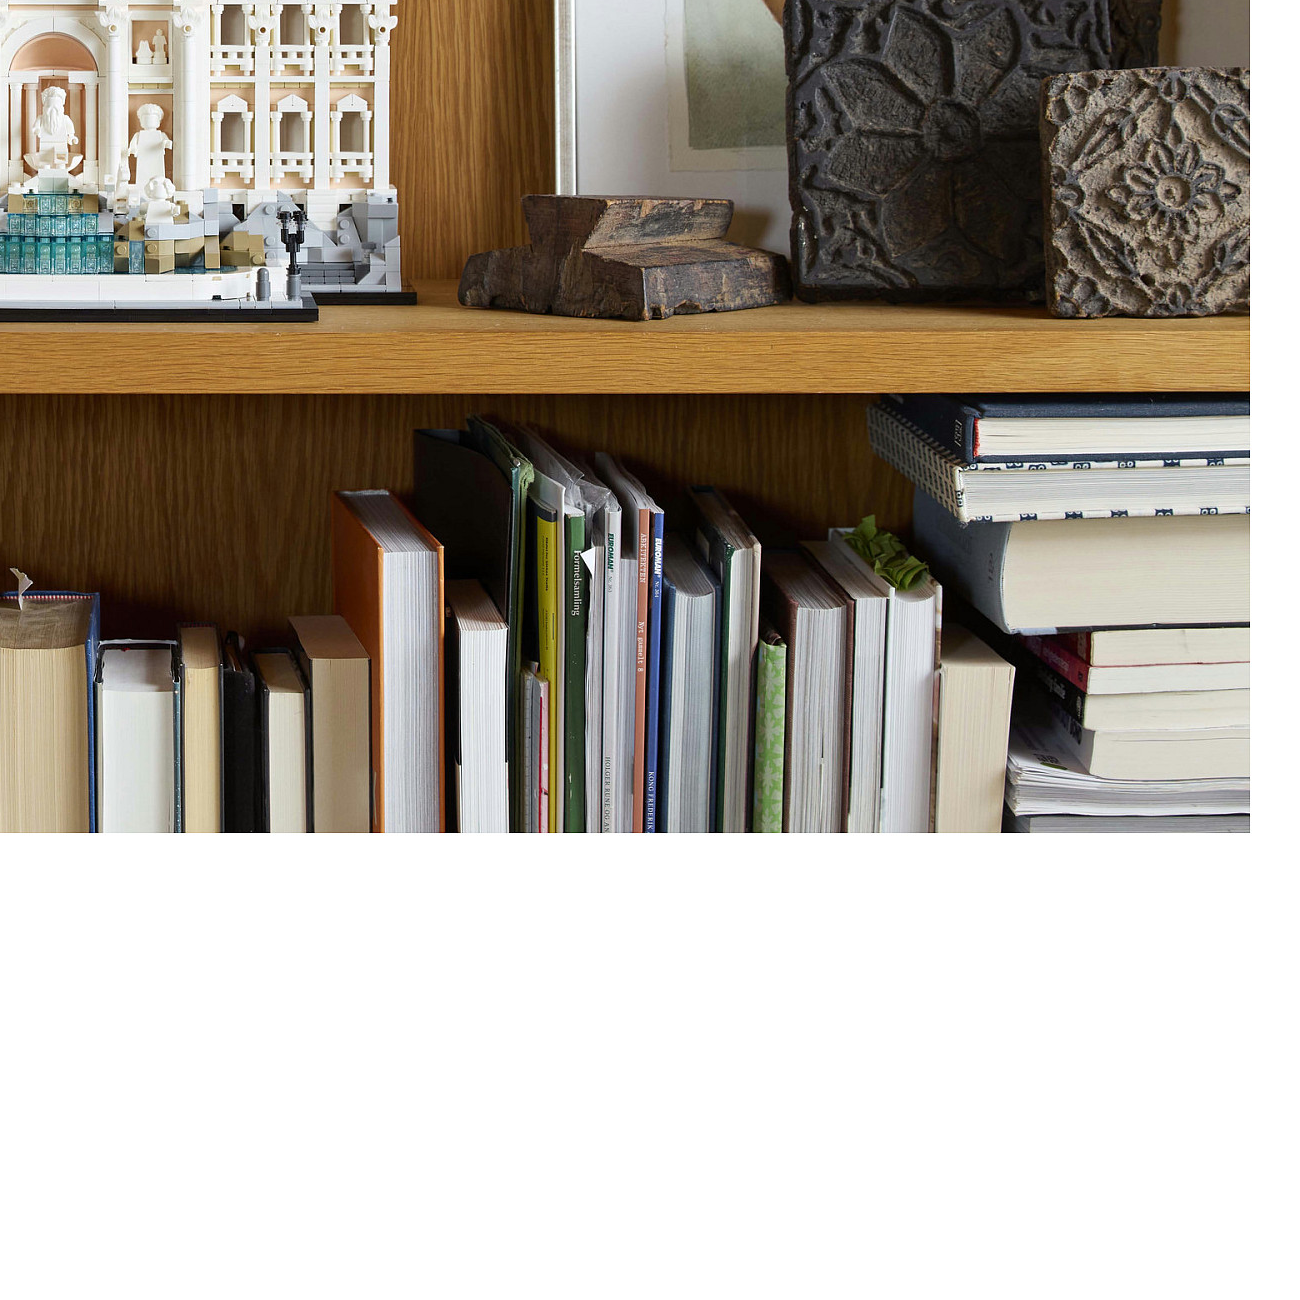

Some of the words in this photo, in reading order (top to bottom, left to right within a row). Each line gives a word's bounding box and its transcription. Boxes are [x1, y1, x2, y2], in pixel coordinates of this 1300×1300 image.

[572, 550, 582, 616] Formelsamling
[639, 533, 647, 583] ARKITEKTEN
[604, 809, 610, 820] OG
